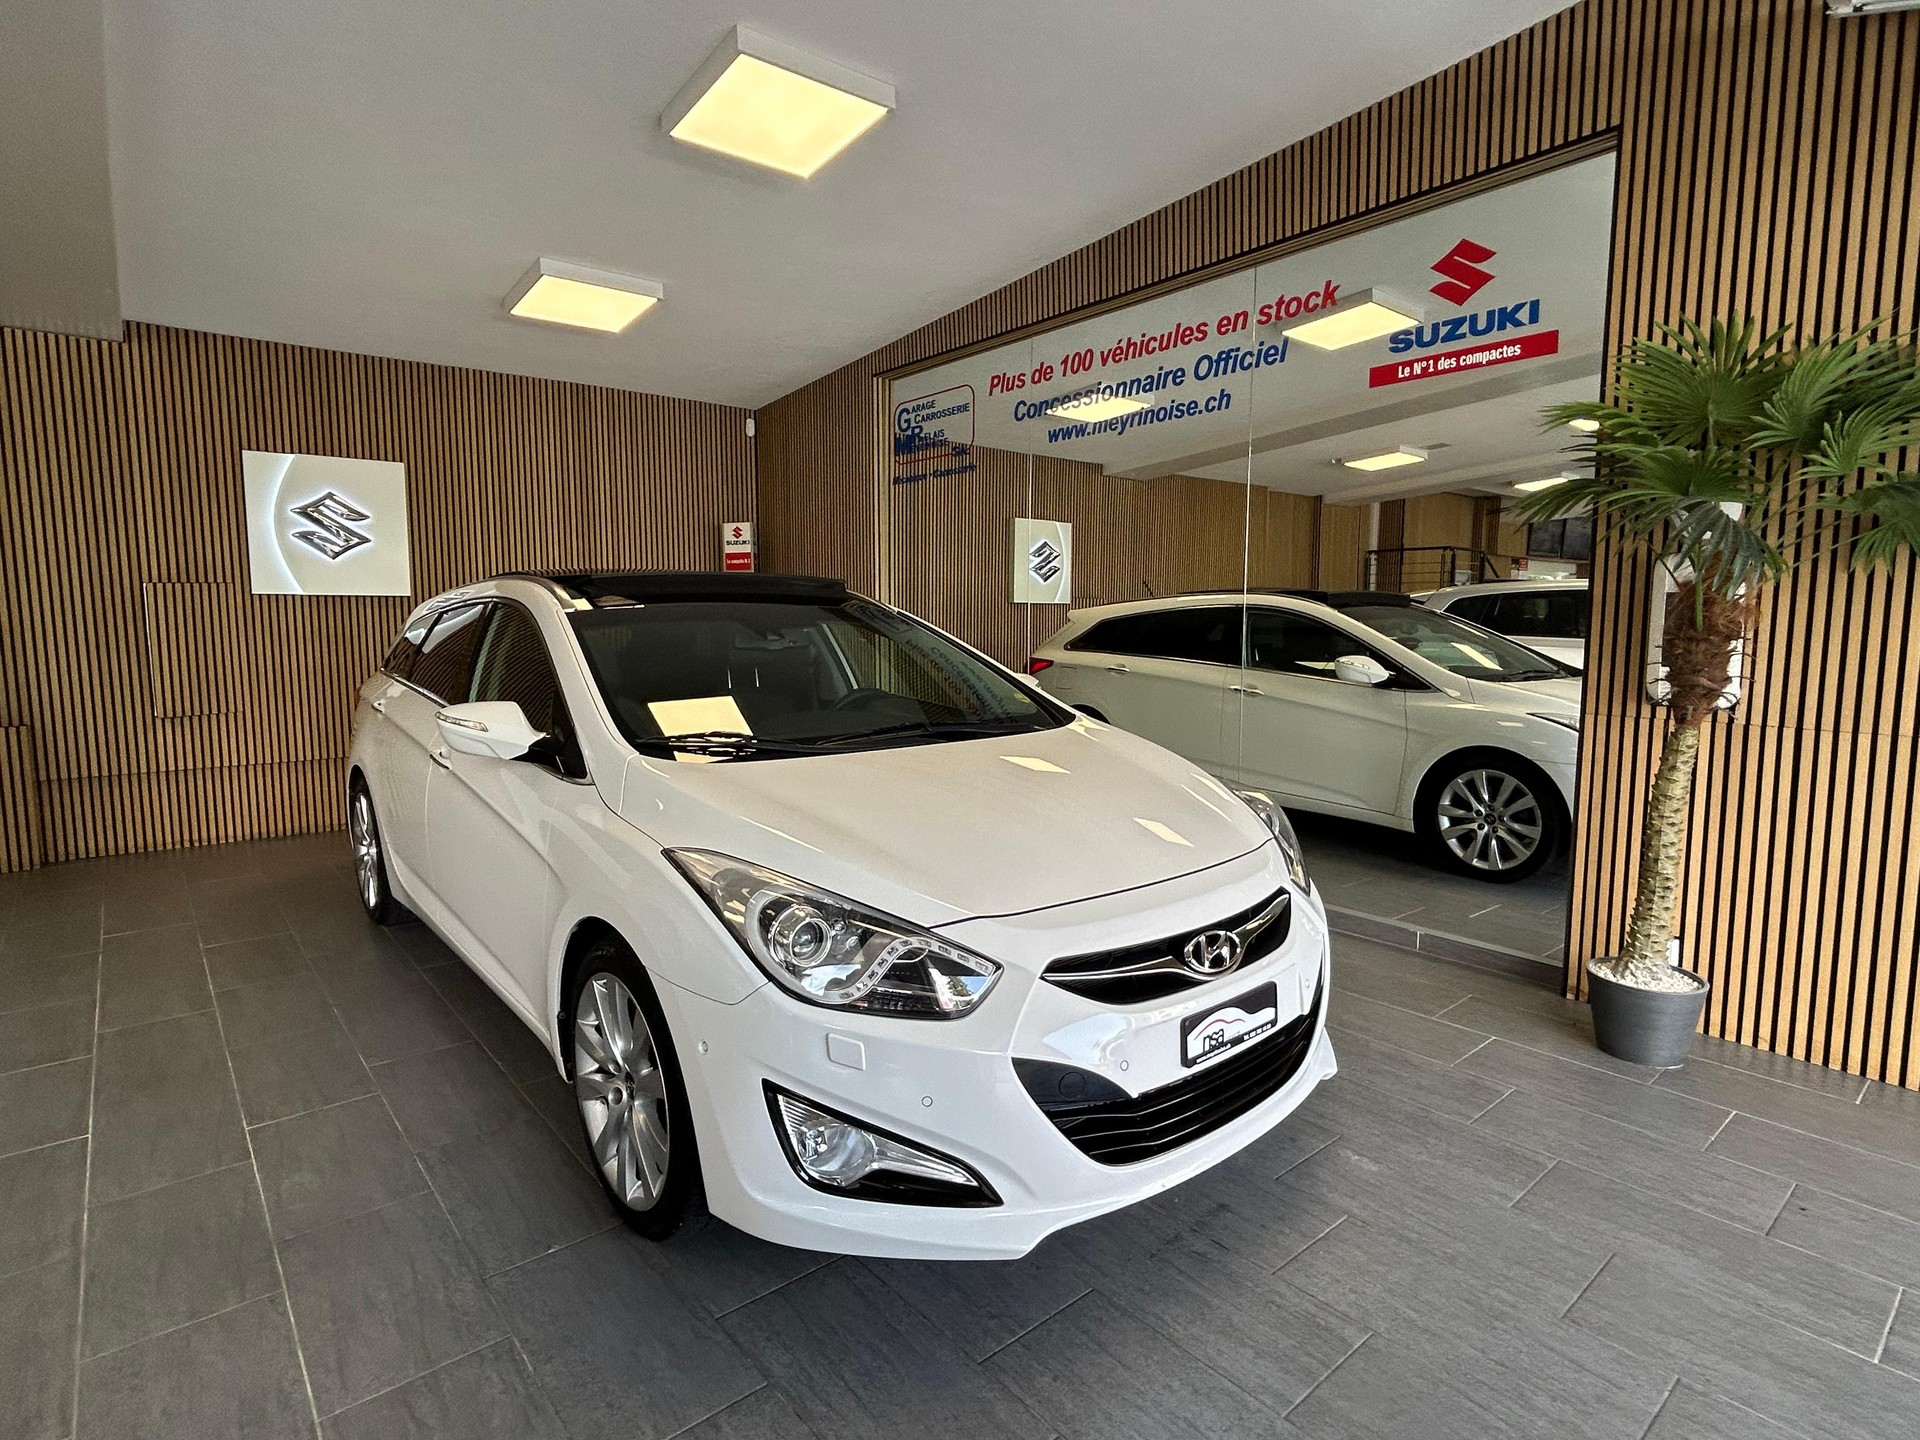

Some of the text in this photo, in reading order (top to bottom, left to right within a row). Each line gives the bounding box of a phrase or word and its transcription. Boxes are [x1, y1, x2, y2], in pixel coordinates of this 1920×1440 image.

[988, 279, 1340, 396] Plus de 100 véhicules en stock
[1388, 299, 1540, 354] SUZUKI
[1014, 336, 1290, 422] Concessionnaire Officiel
[1398, 365, 1411, 378] Le
[1437, 356, 1456, 371] des
[1459, 343, 1521, 366] compactes
[914, 403, 970, 424] CARROSSERIE
[1048, 388, 1231, 443] www.meyrinoise.ch
